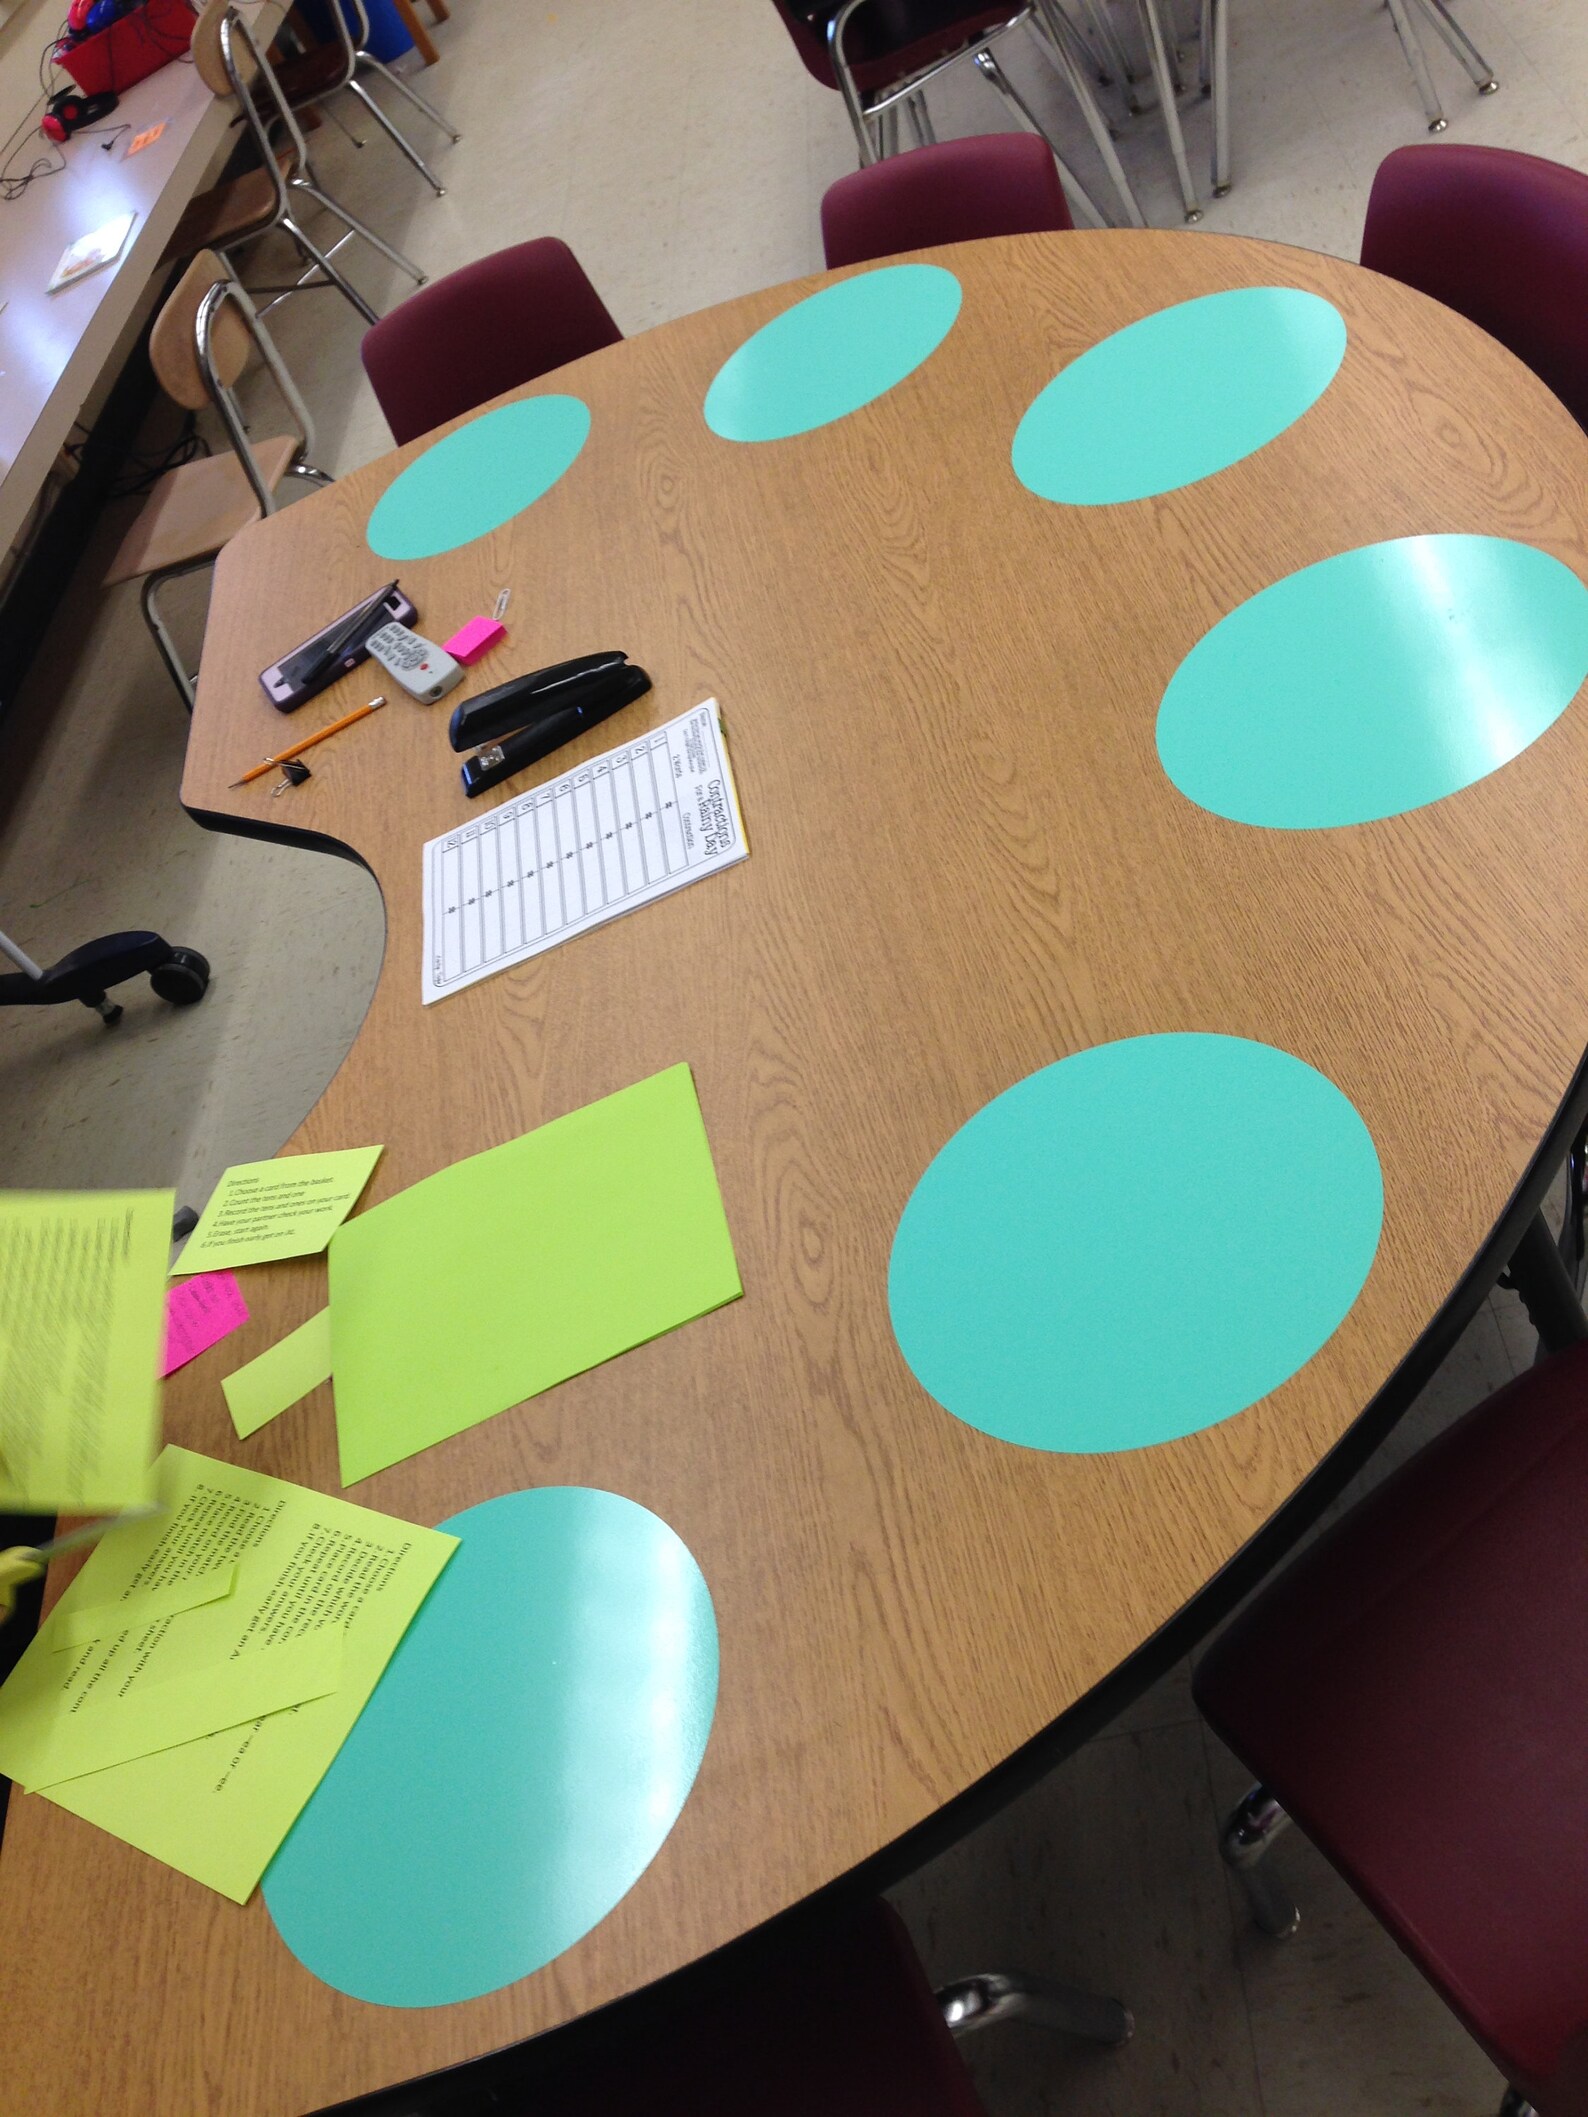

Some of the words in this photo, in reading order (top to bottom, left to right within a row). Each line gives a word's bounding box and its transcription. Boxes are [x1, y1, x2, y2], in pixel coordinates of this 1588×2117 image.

[697, 799, 713, 832] Rainy
[707, 776, 734, 848] Contractions
[704, 832, 719, 856] Day
[176, 1504, 191, 1520] you
[252, 1500, 286, 1547] Directions
[158, 1523, 179, 1547] finish
[171, 1525, 188, 1544] your
[176, 1533, 193, 1554] until
[186, 1528, 208, 1557] match
[217, 1531, 231, 1546] the
[201, 1539, 212, 1551] on
[225, 1538, 239, 1553] the
[293, 1542, 309, 1559] you
[141, 1549, 159, 1572] early
[163, 1556, 178, 1573] you
[178, 1559, 188, 1568] in
[186, 1554, 203, 1574] your
[376, 1542, 412, 1591] Directions
[129, 1573, 143, 1588] get
[167, 1570, 181, 1586] the
[275, 1562, 297, 1587] finish
[288, 1567, 305, 1589] your
[310, 1571, 328, 1593] card
[294, 1576, 312, 1599] until
[321, 1584, 333, 1596] on
[347, 1582, 362, 1598] the
[258, 1590, 277, 1614] early
[303, 1595, 315, 1604] in
[311, 1599, 325, 1616] the
[323, 1587, 345, 1616] which
[281, 1601, 297, 1619] you
[292, 1607, 307, 1624] the
[246, 1615, 260, 1632] get
[237, 1635, 248, 1647] an
[265, 1621, 285, 1646] have
[79, 1646, 93, 1665] and
[108, 1644, 120, 1657] up
[99, 1658, 109, 1671] all
[133, 1652, 152, 1673] with
[86, 1673, 101, 1689] the
[118, 1676, 136, 1697] your
